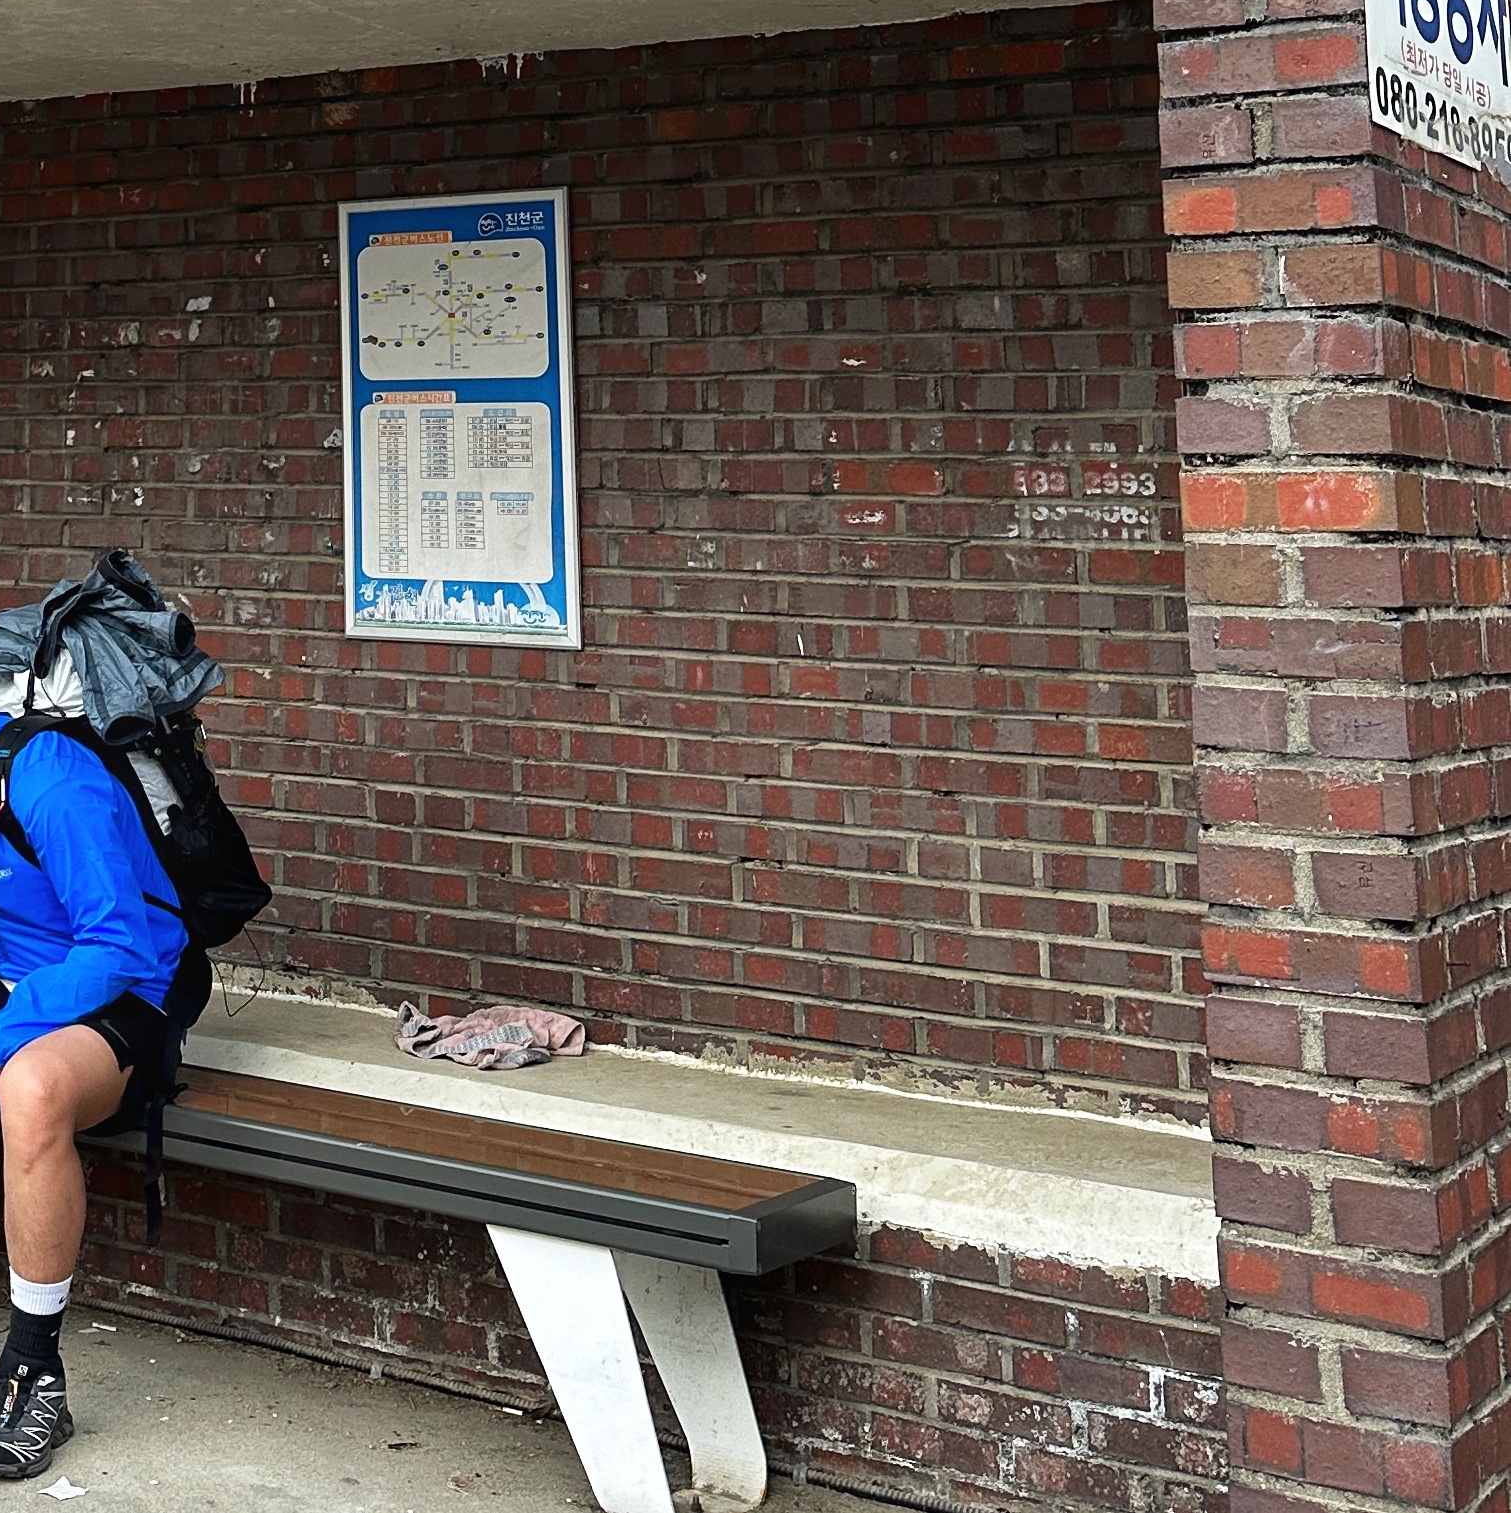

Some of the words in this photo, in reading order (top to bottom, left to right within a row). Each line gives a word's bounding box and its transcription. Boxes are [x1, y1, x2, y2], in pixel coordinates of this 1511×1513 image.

[1401, 36, 1440, 82] (최저가
[1442, 62, 1462, 95] 당일
[1466, 77, 1491, 109] 시공)
[505, 211, 544, 226] 진천군
